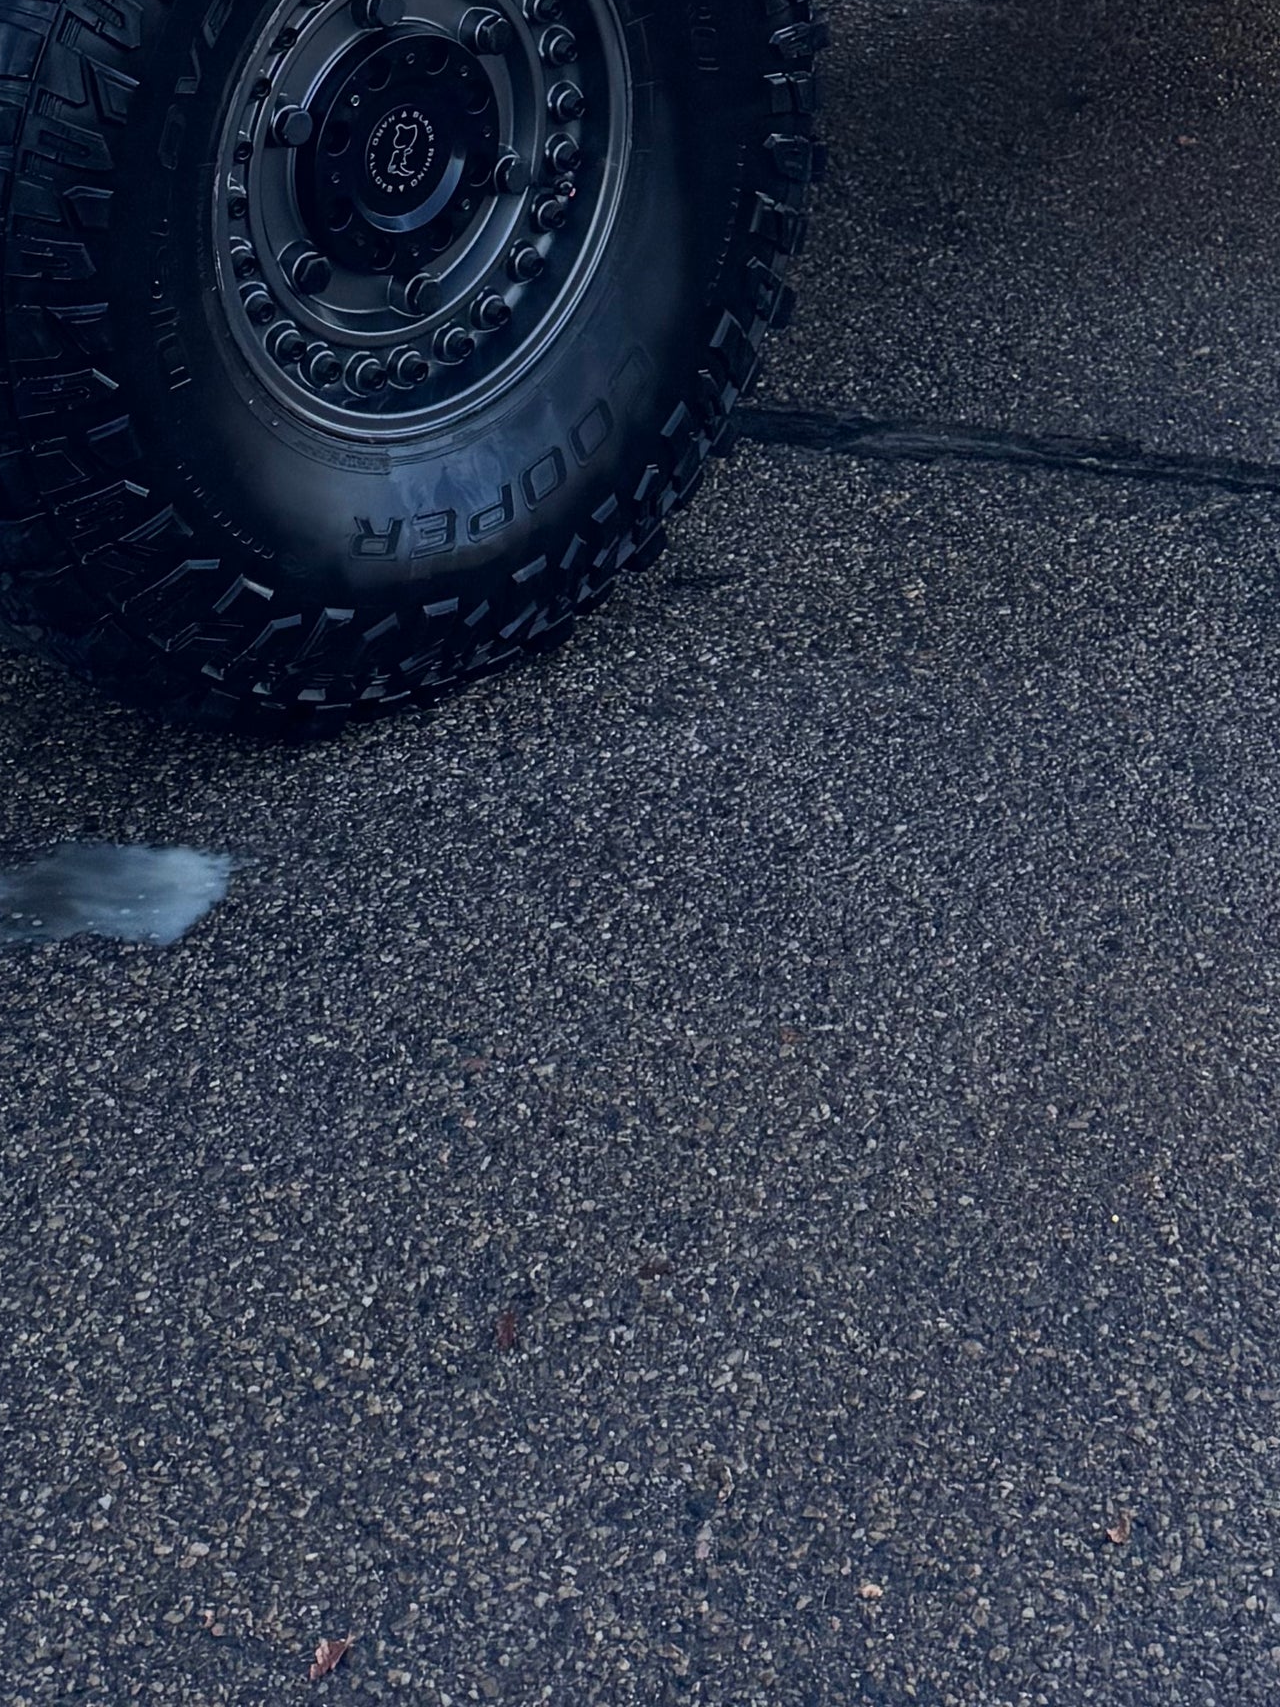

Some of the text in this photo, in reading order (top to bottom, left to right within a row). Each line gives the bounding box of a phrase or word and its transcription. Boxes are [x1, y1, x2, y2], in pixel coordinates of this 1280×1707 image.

[369, 115, 396, 193] HARD ALLOYS
[410, 110, 435, 187] BLACK RHINO
[349, 342, 655, 562] COOPER
